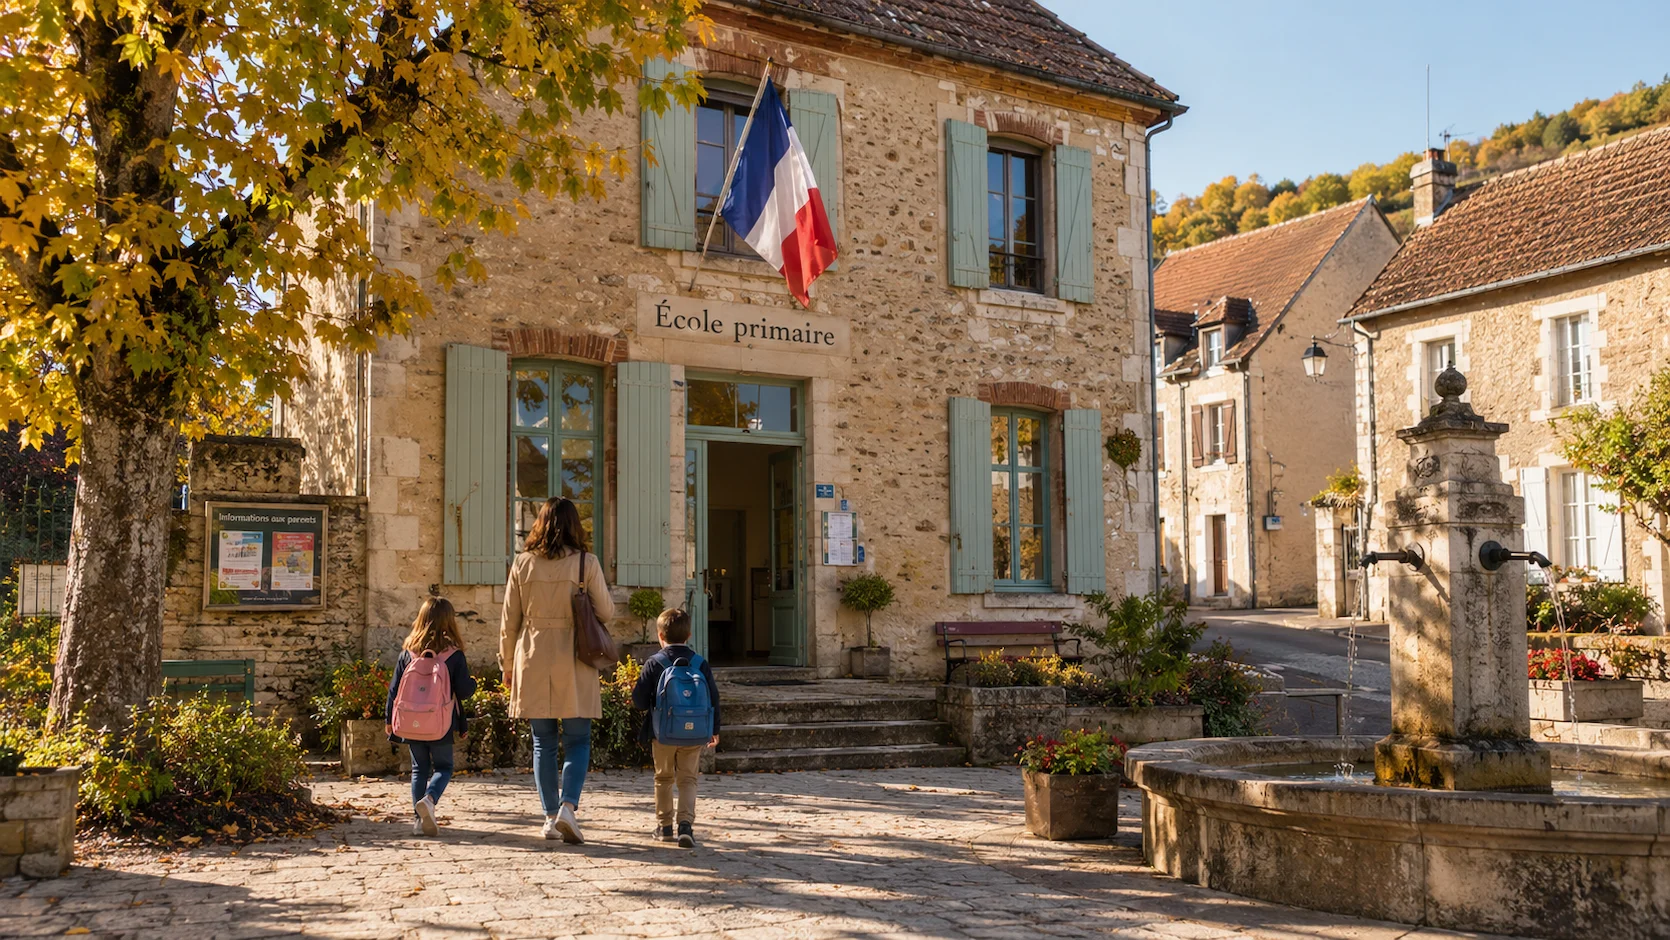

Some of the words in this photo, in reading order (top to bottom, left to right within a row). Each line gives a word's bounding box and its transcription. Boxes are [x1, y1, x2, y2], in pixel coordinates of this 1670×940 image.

[654, 299, 723, 334] École
[734, 317, 835, 346] primaire
[219, 513, 270, 522] Informations
[287, 516, 317, 525] parents
